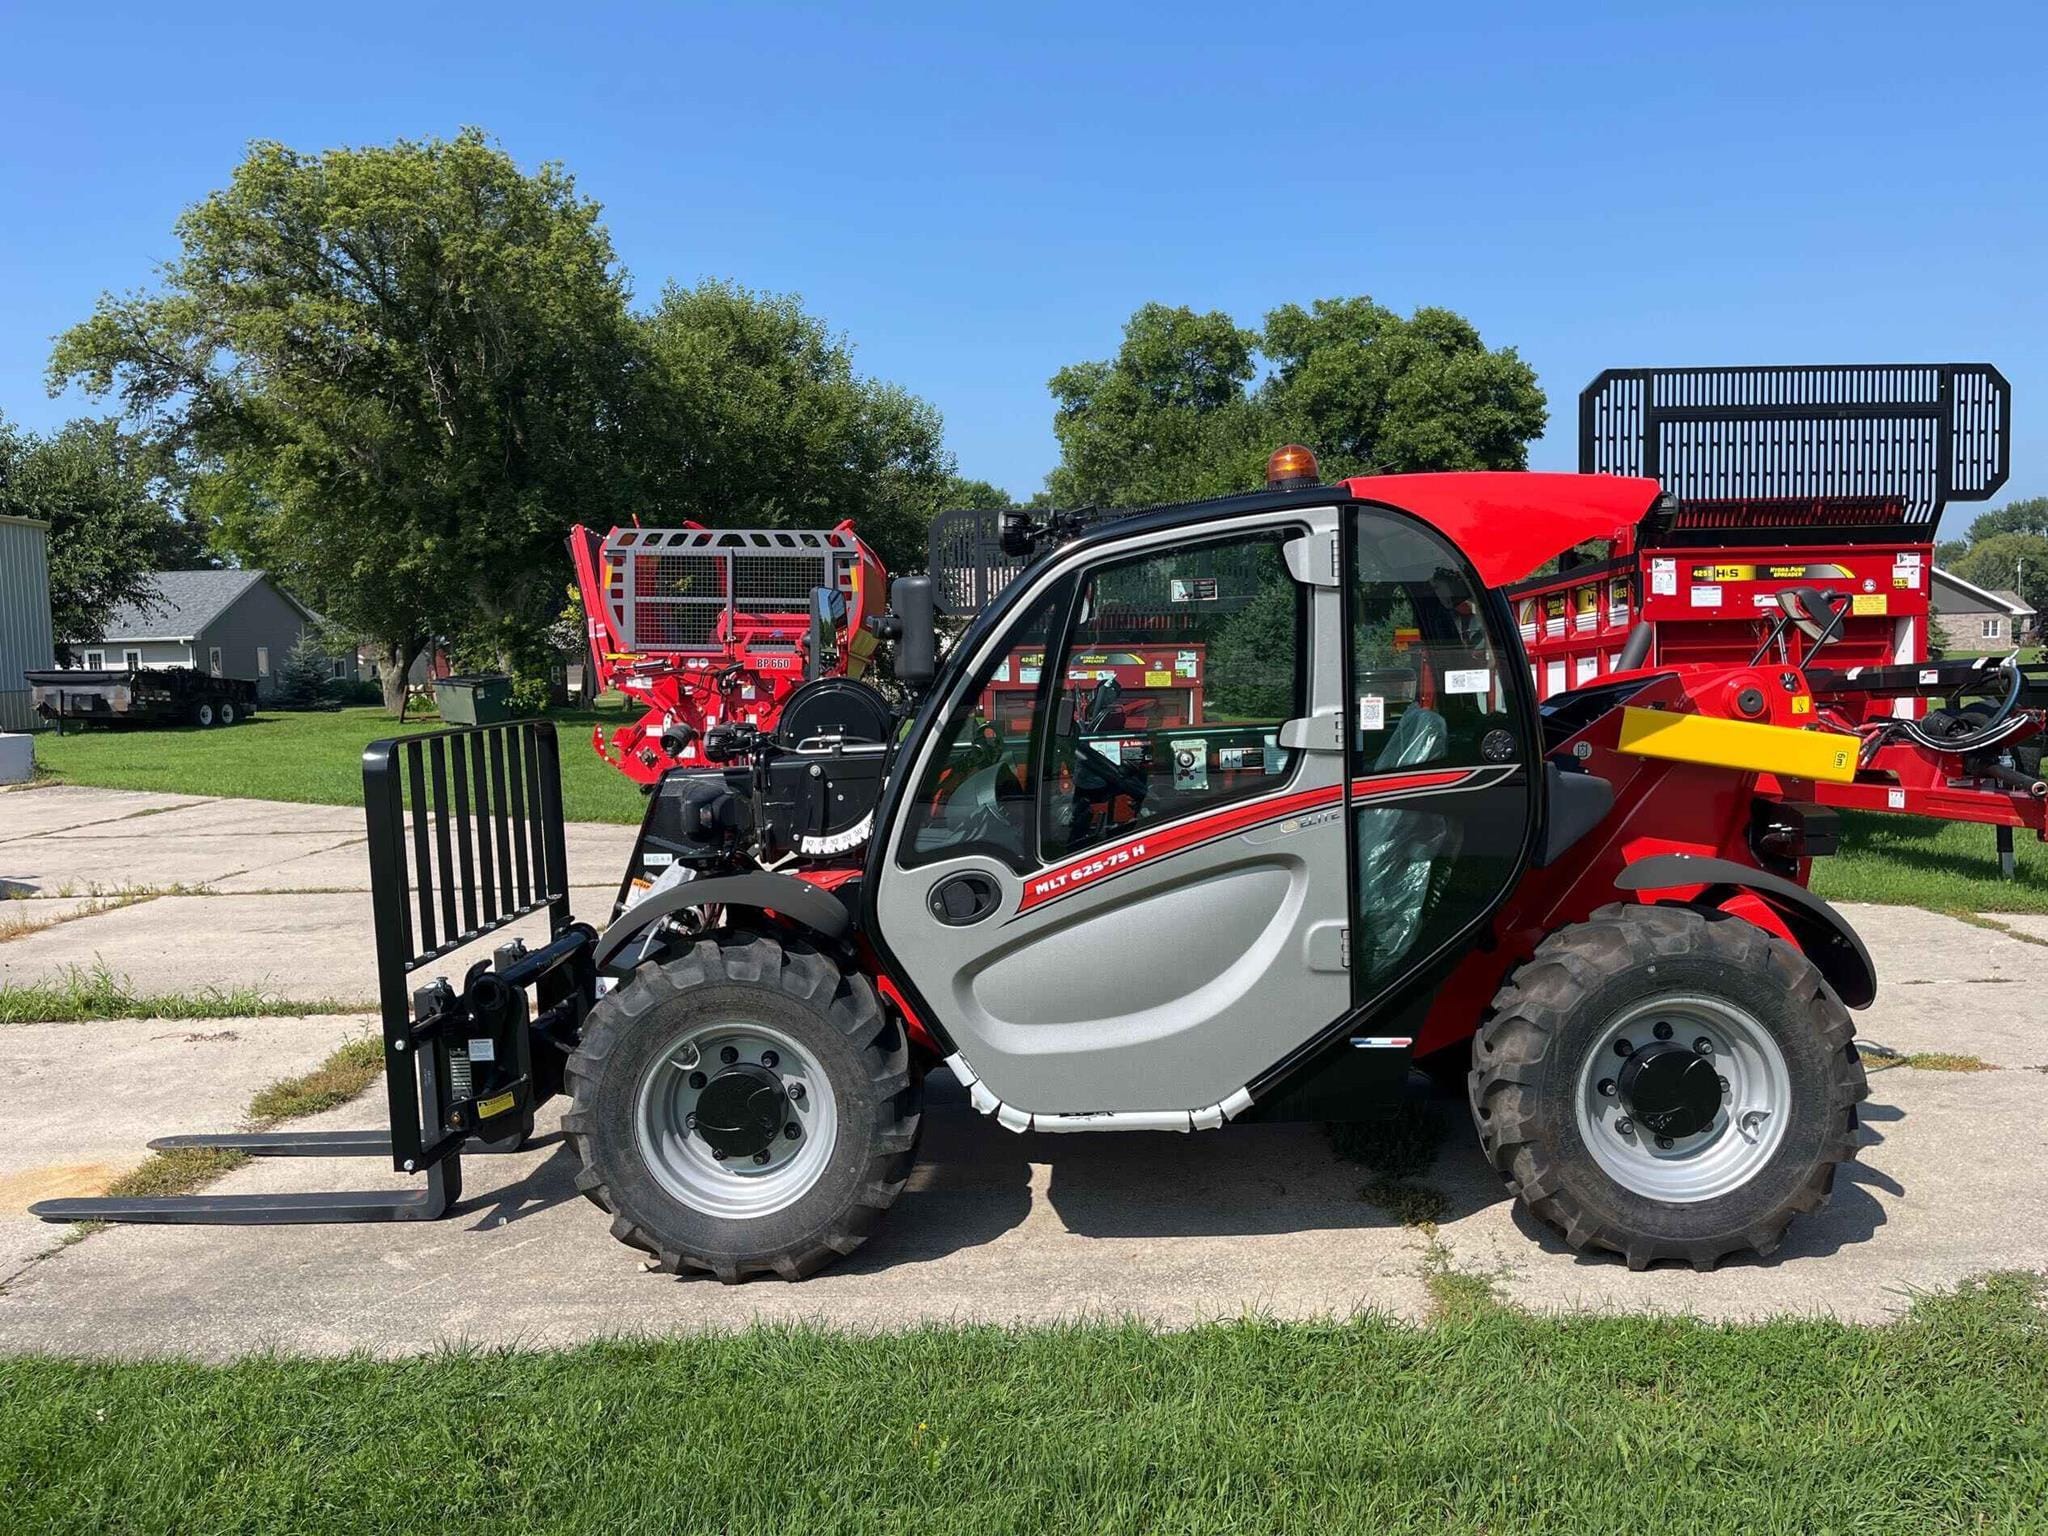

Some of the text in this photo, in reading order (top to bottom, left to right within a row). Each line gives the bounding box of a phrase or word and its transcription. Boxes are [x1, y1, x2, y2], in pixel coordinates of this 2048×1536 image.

[757, 659, 790, 668] BP 660
[1300, 810, 1340, 828] ELITE
[1035, 845, 1146, 895] MLT 625-75 H
